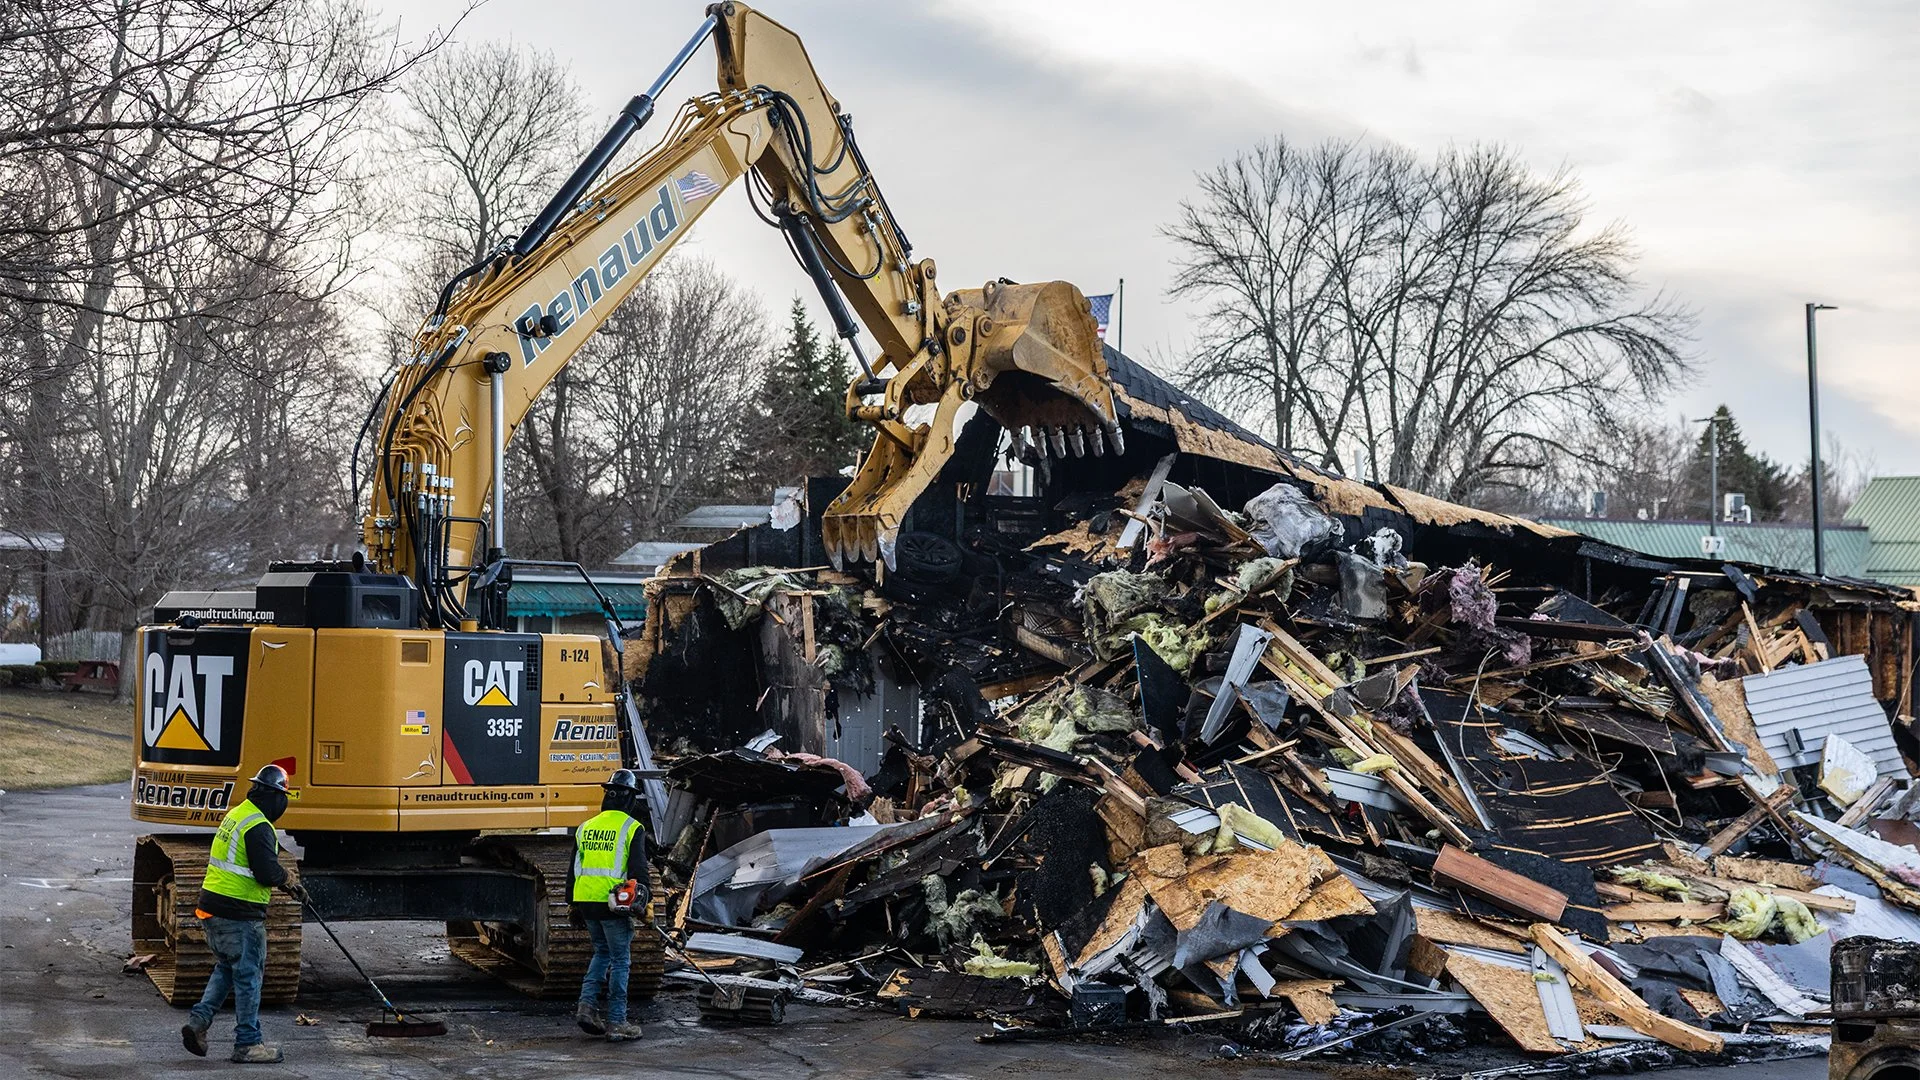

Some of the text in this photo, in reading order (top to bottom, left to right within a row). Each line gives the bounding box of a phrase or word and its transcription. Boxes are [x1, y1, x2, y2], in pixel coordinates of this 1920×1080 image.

[513, 182, 679, 369] Renaud
[560, 649, 589, 662] R-124
[463, 659, 524, 706] CAT
[144, 652, 234, 751] CAT
[487, 718, 523, 737] 335F
[514, 739, 522, 754] L
[152, 772, 185, 783] WILLIAM
[135, 776, 235, 811] Renaud
[415, 791, 534, 803] renaudtrucking.com
[188, 811, 202, 821] JR
[584, 829, 617, 841] RENAUD
[581, 841, 614, 852] TRUCKING
